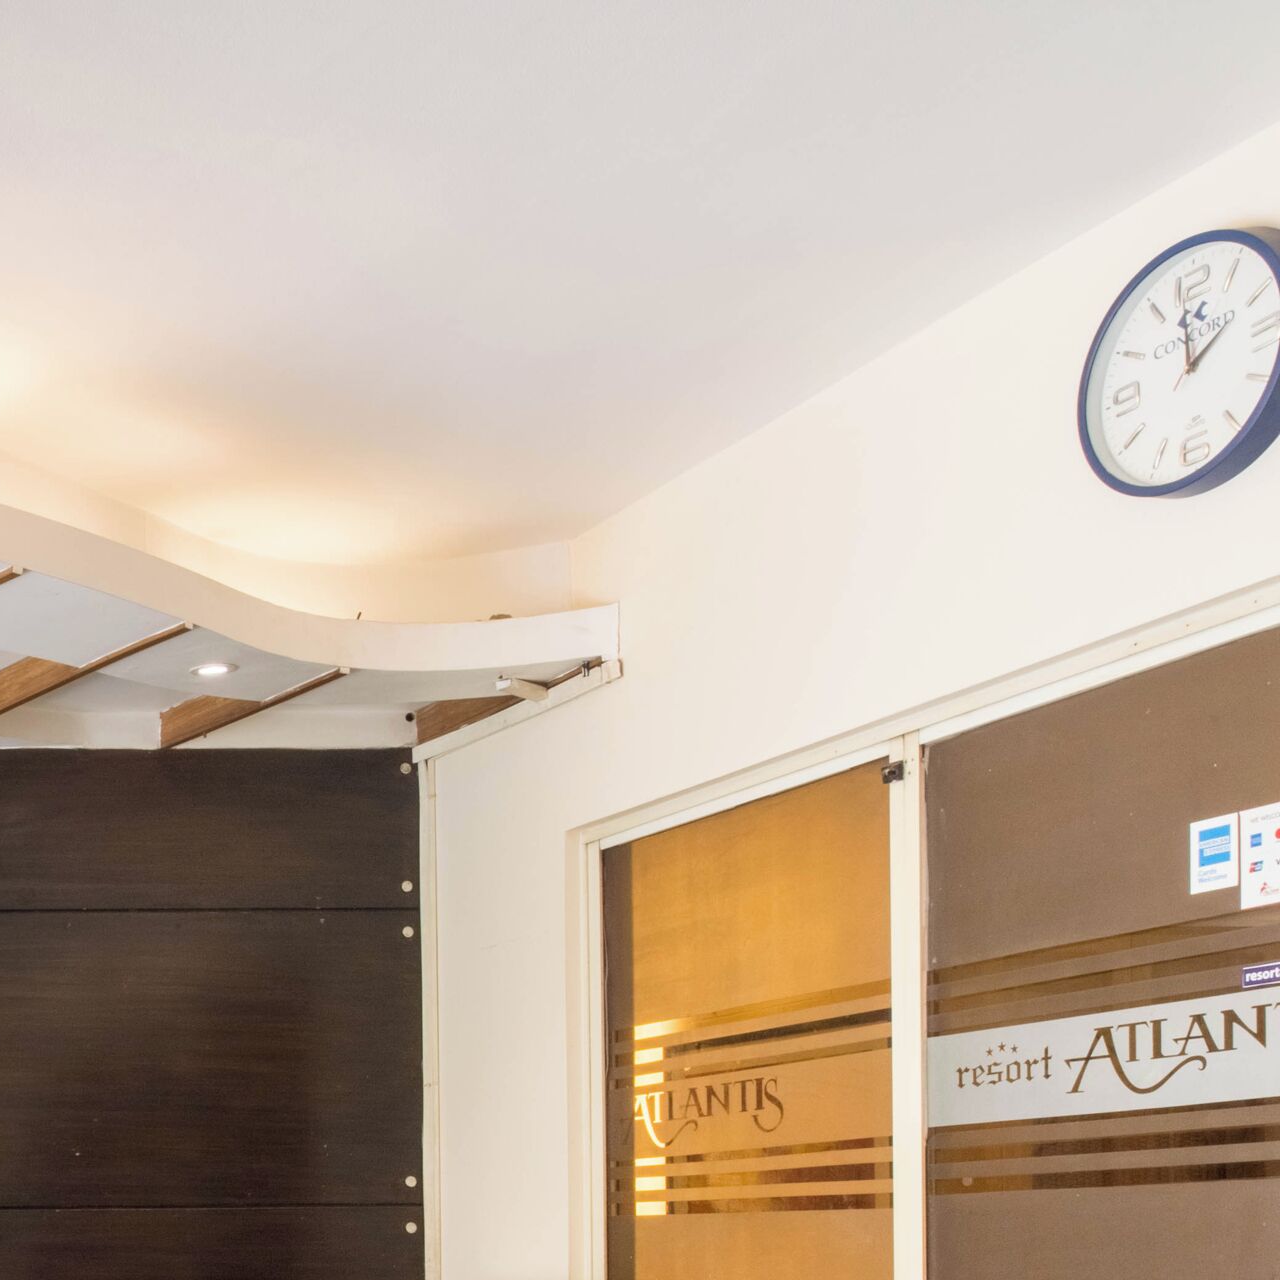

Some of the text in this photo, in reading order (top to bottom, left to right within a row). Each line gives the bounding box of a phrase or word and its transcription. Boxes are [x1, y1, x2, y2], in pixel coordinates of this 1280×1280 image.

[1245, 967, 1280, 982] resort
[956, 1001, 1280, 1095] resort ATLAN
